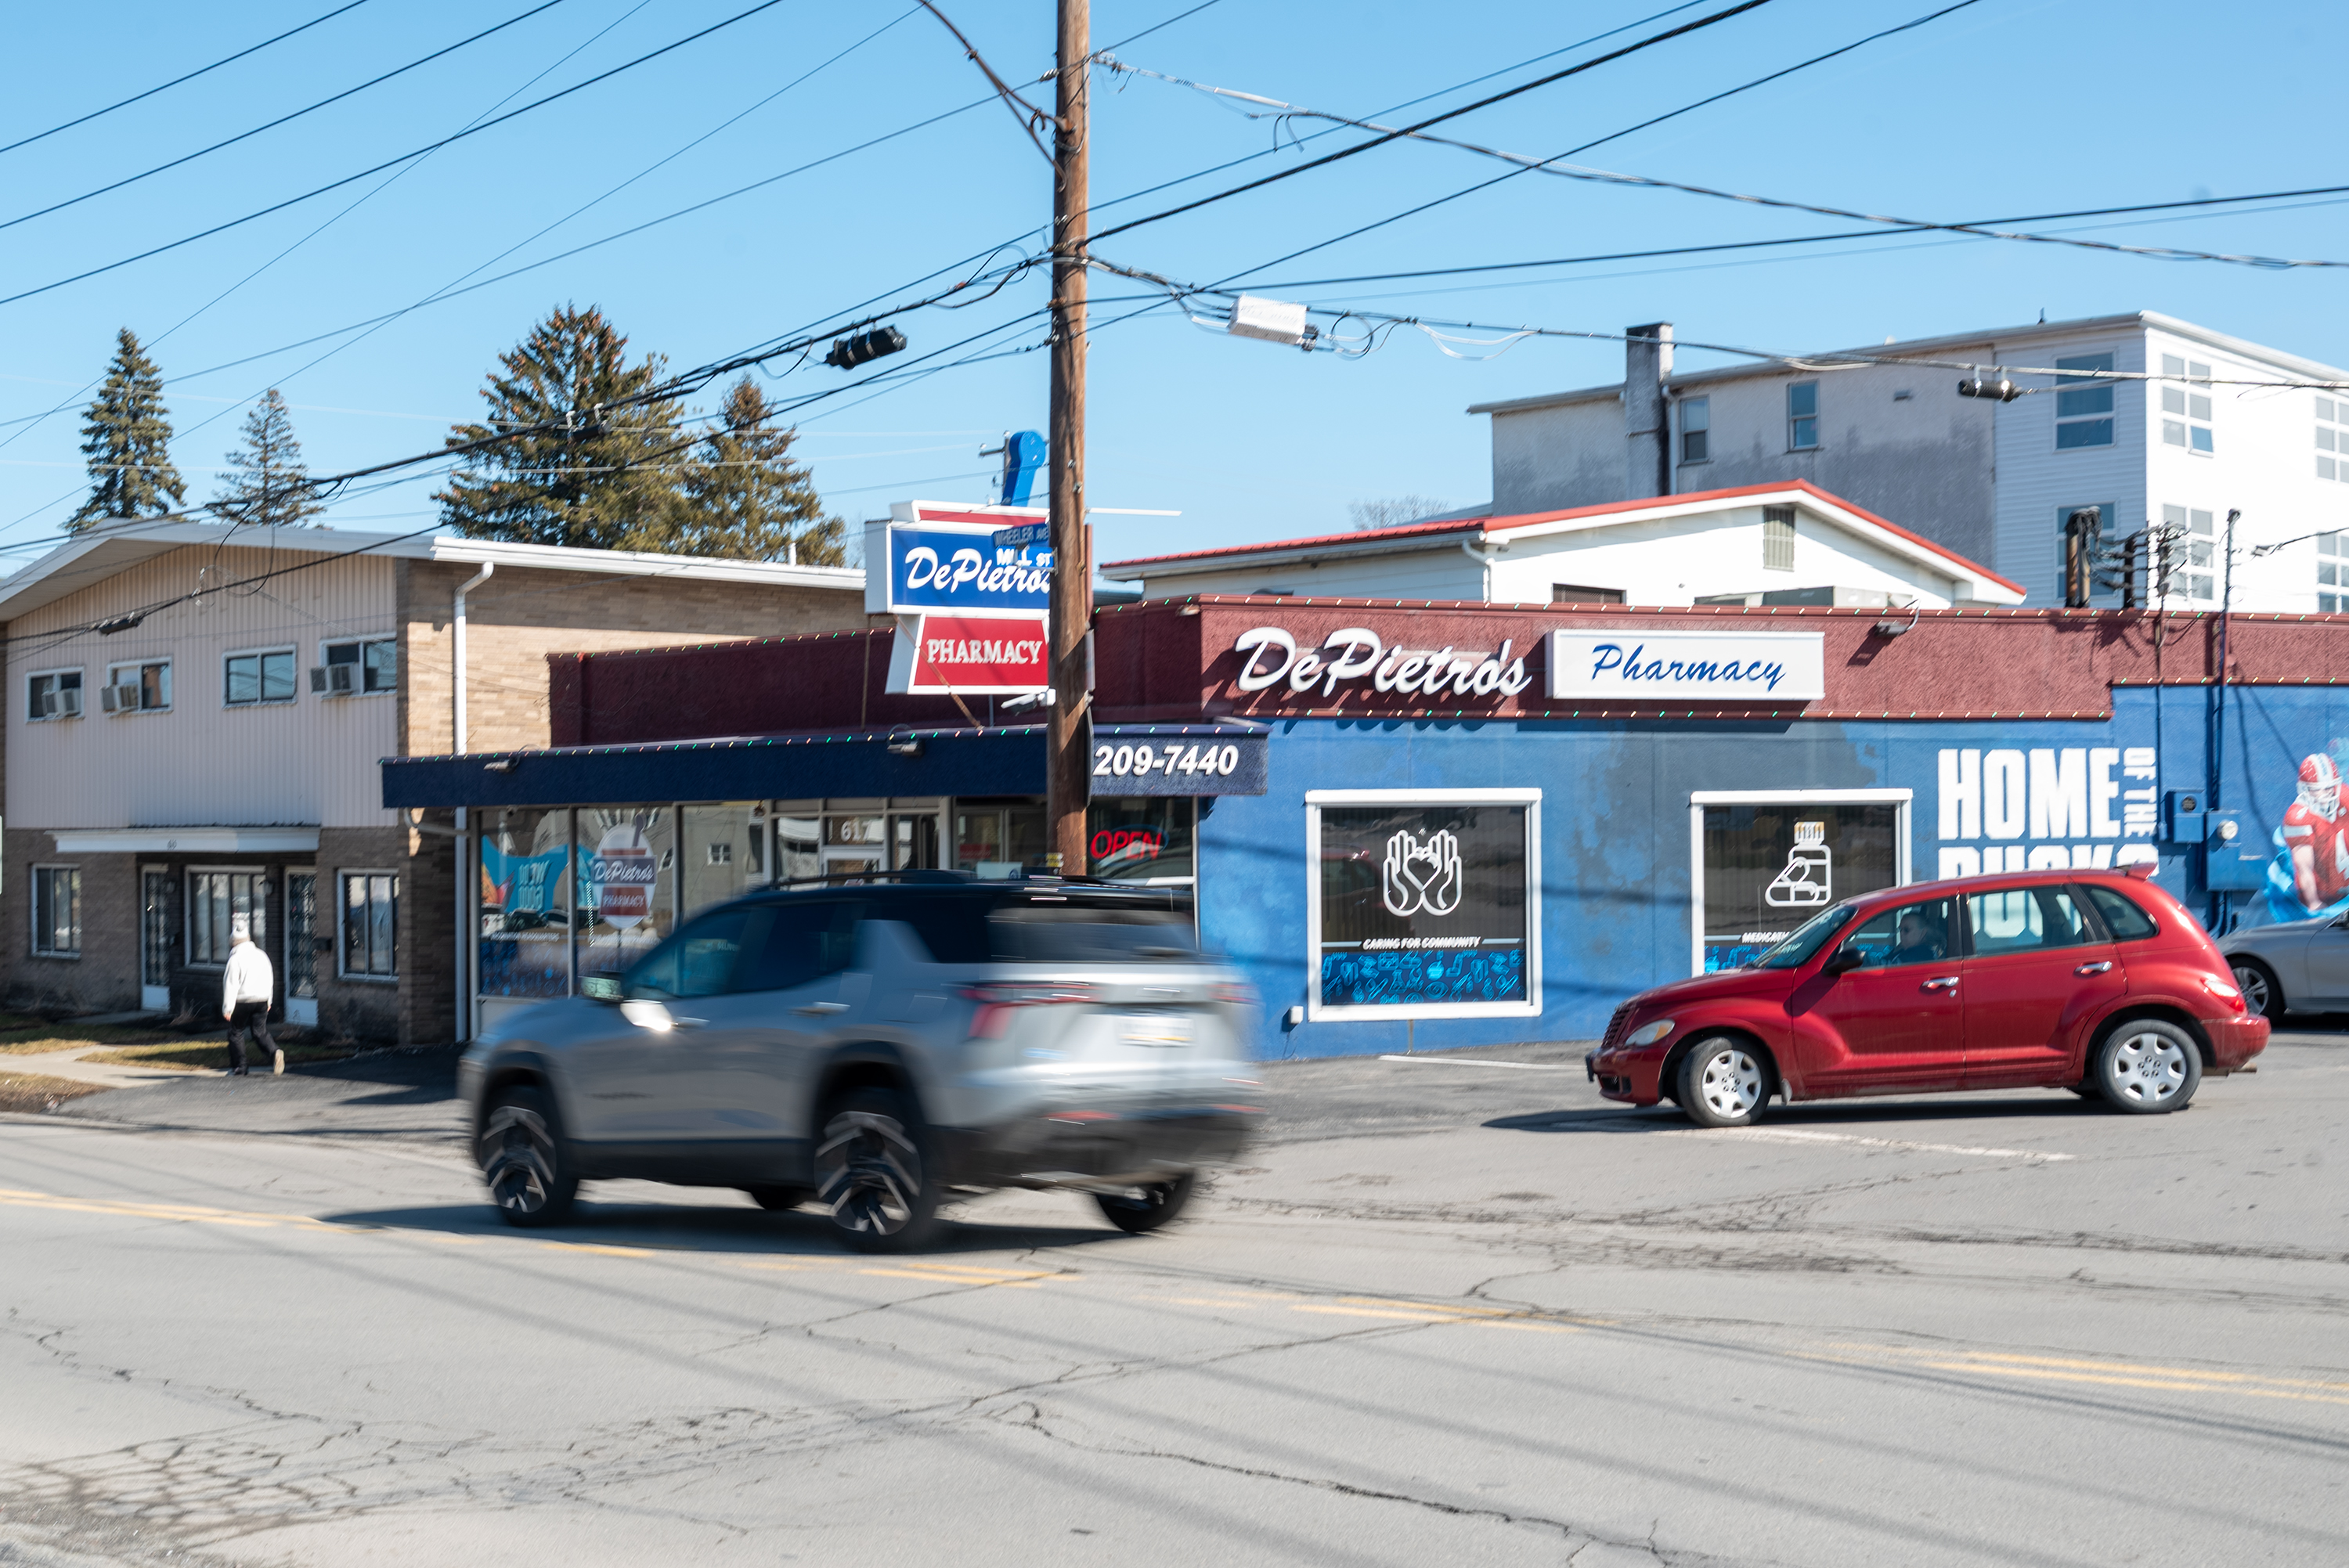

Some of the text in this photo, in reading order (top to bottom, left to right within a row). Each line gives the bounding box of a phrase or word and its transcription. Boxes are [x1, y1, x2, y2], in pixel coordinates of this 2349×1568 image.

[994, 526, 1034, 546] WHEELER
[1036, 553, 1051, 567] ST
[926, 639, 1043, 664] PHARMACY
[1235, 626, 1532, 697] DePietro's
[1591, 643, 1787, 692] Pharmacy
[1093, 745, 1239, 776] 209-7440
[1938, 748, 2120, 840] HOME
[2123, 747, 2157, 838] OF THE
[840, 820, 872, 842] 617
[1090, 830, 1163, 859] OPEN
[602, 895, 646, 907] PHARMACY
[1362, 936, 1481, 950] CARING FOR COMMUNITY
